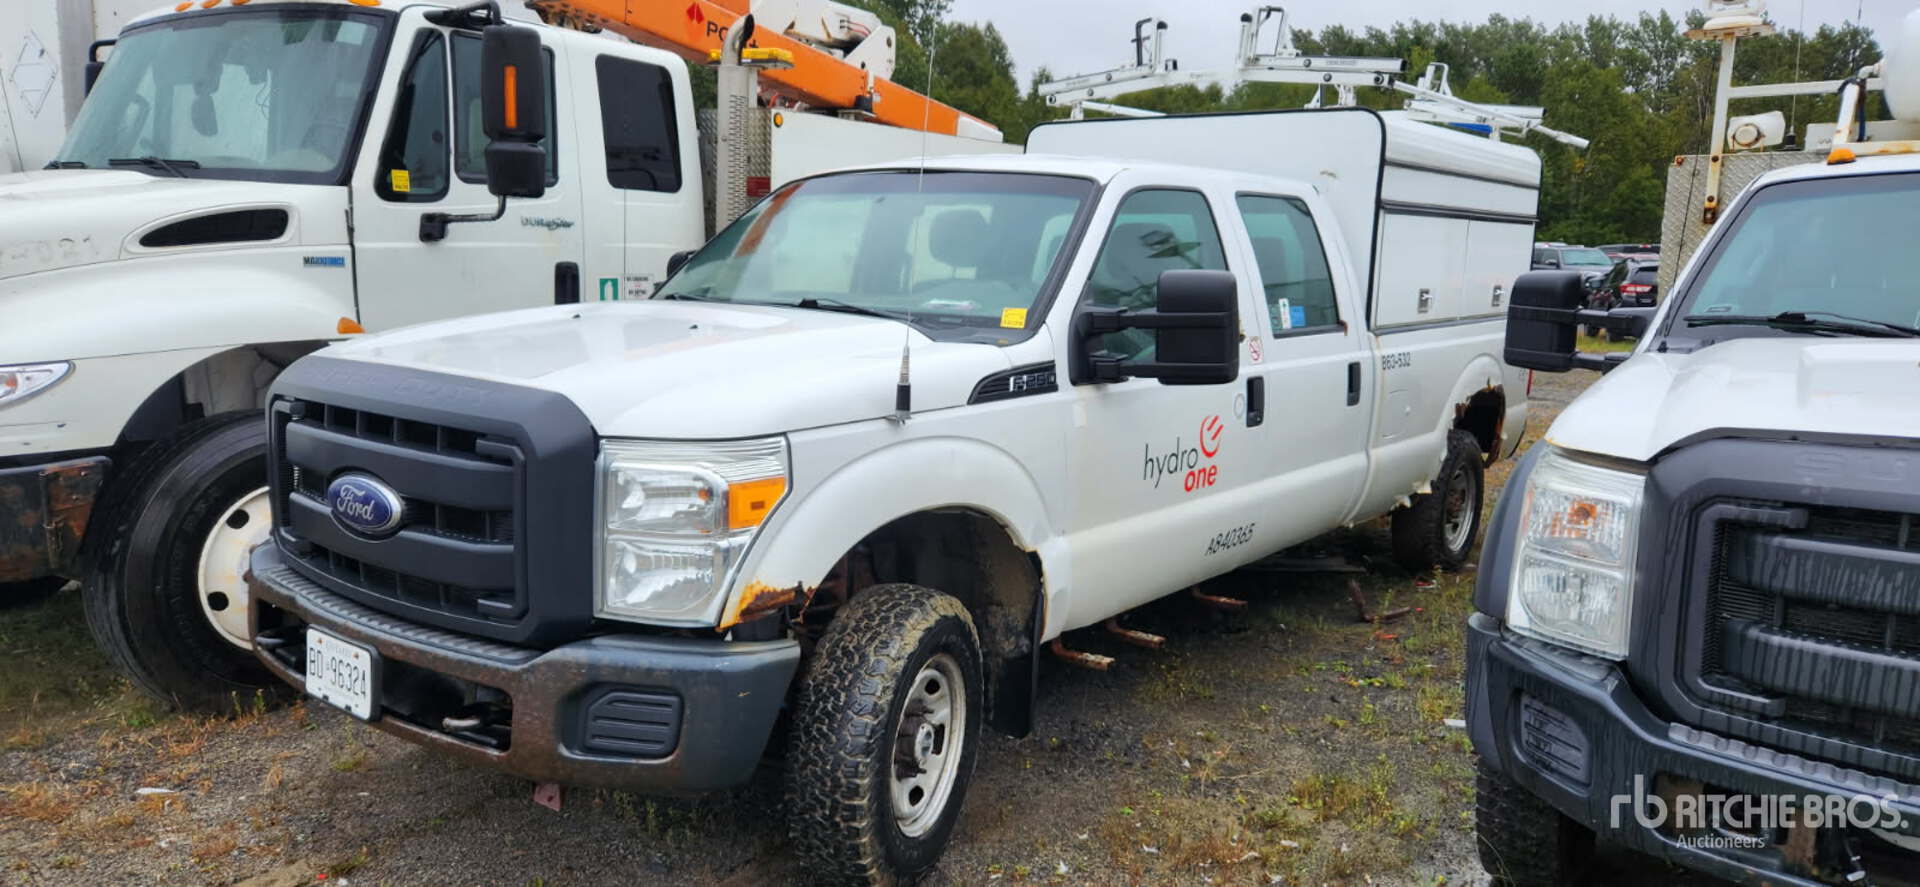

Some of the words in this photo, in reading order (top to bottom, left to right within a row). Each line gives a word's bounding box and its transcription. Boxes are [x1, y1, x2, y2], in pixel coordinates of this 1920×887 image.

[1143, 436, 1199, 489] hydro
[1184, 464, 1218, 492] one
[336, 484, 376, 521] Ford
[1204, 523, 1256, 557] A840365
